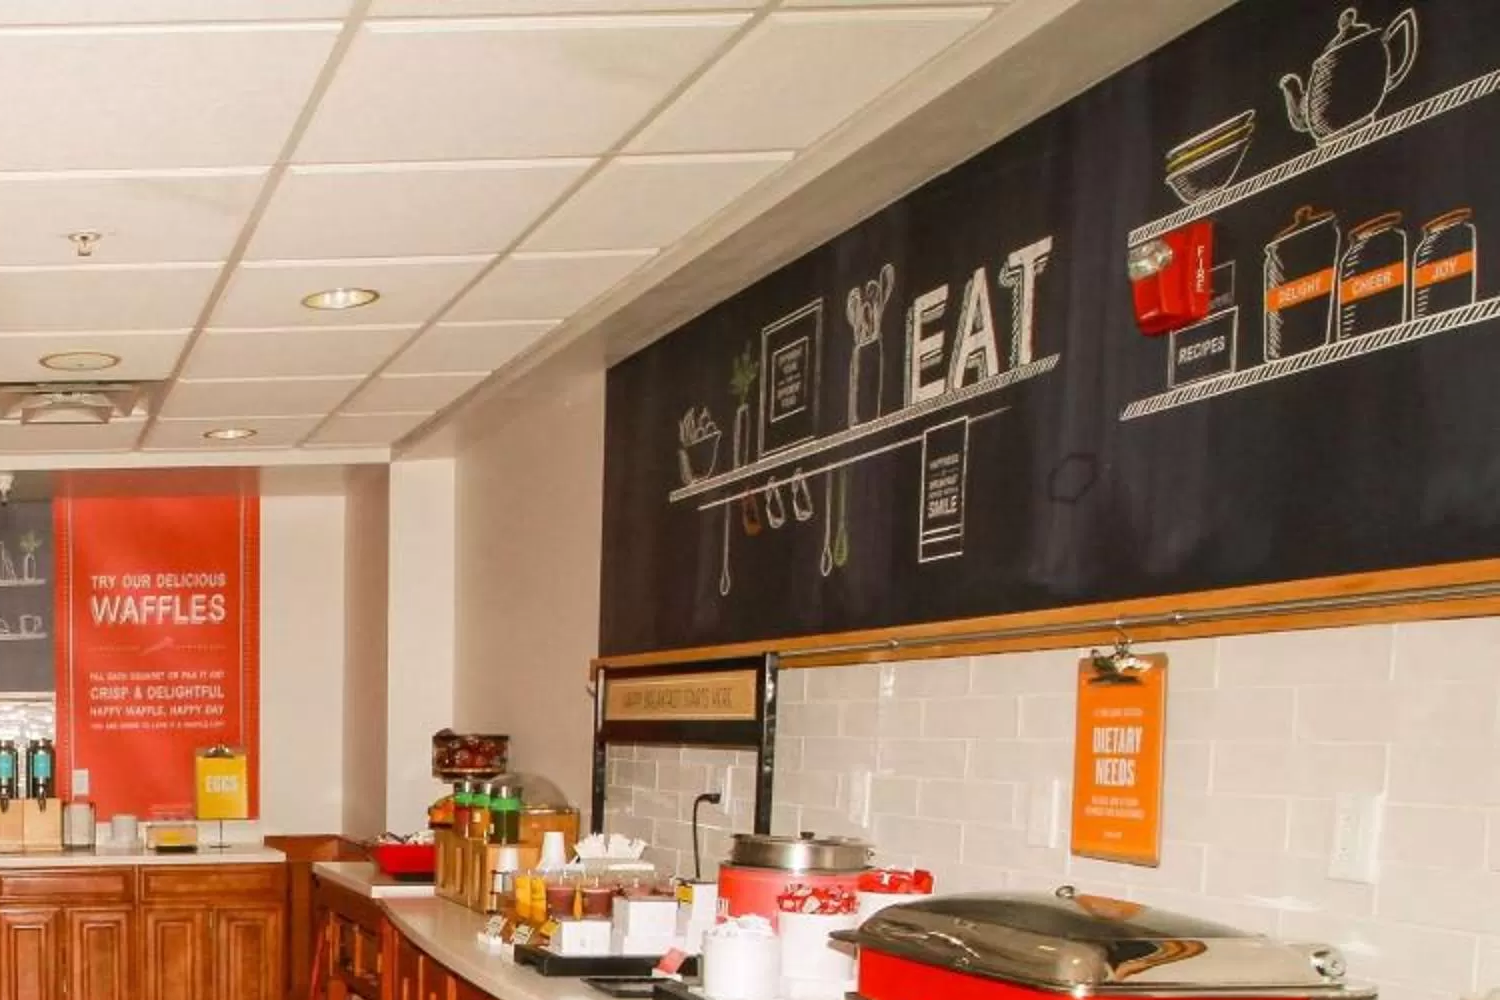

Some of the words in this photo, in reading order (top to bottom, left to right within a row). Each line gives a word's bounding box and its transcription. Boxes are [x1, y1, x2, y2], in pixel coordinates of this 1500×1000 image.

[1196, 245, 1205, 293] FIRE
[1431, 259, 1457, 280] JOY
[1278, 278, 1321, 302] DELIGHT
[1351, 272, 1392, 296] CHEER
[904, 236, 1053, 408] EAT
[1178, 335, 1226, 365] RECIPES
[928, 495, 958, 519] SMILE
[90, 575, 116, 589] TRY
[123, 574, 150, 589] OUR
[156, 573, 226, 589] DELICIOUS
[90, 594, 226, 625] WAFFLES
[90, 686, 129, 700] CRISP
[147, 685, 225, 699] DELIGHTFUL
[90, 706, 122, 717] HAPPY
[170, 705, 202, 716] HAPPY
[205, 704, 224, 716] DAY
[1092, 726, 1143, 754] DIETARY
[1095, 757, 1137, 787] NEEDS
